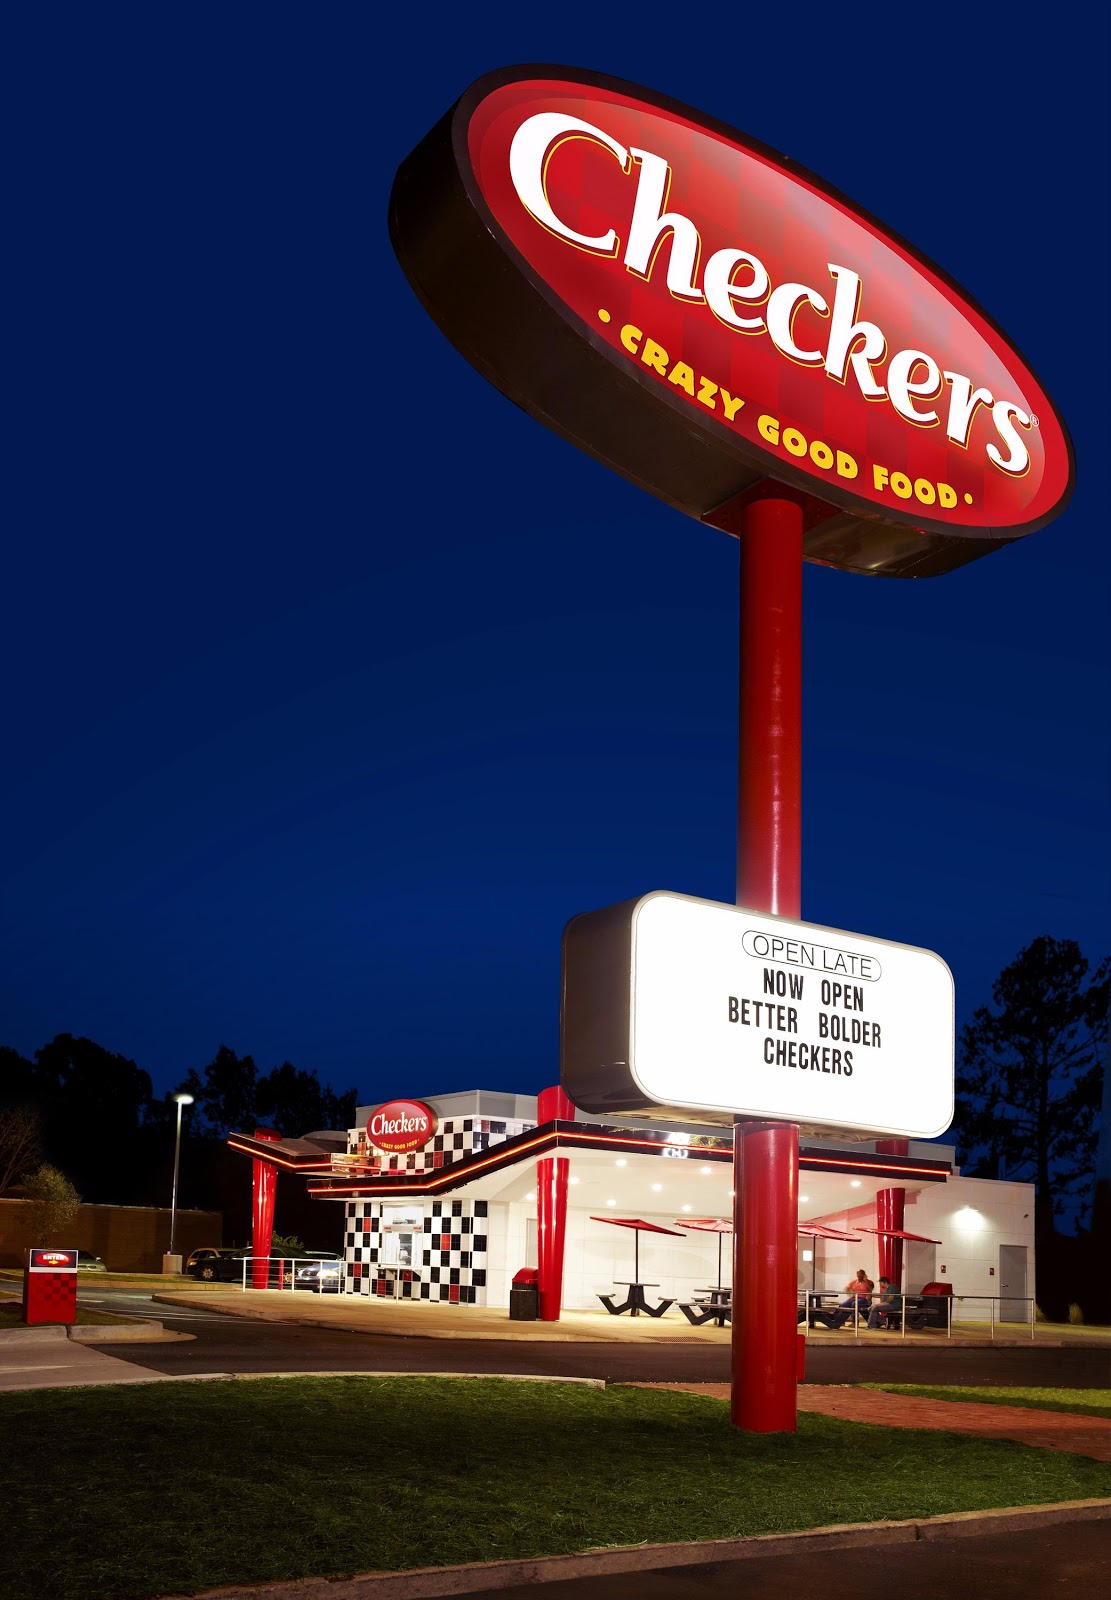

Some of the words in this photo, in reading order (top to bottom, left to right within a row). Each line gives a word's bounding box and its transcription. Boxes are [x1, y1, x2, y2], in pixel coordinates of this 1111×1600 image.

[509, 112, 1032, 478] Checkers
[620, 324, 745, 421] CRAZY
[757, 414, 858, 479] GOOD
[872, 464, 958, 508] FOOD
[753, 935, 815, 966] OPEN
[823, 949, 872, 979] LATE
[764, 968, 804, 1000] NOW
[821, 980, 864, 1012] OPEN
[729, 996, 798, 1034] BETTER
[819, 1013, 881, 1048] BOLDER
[764, 1037, 853, 1076] CHECKERS
[371, 1111, 428, 1136] Checkers
